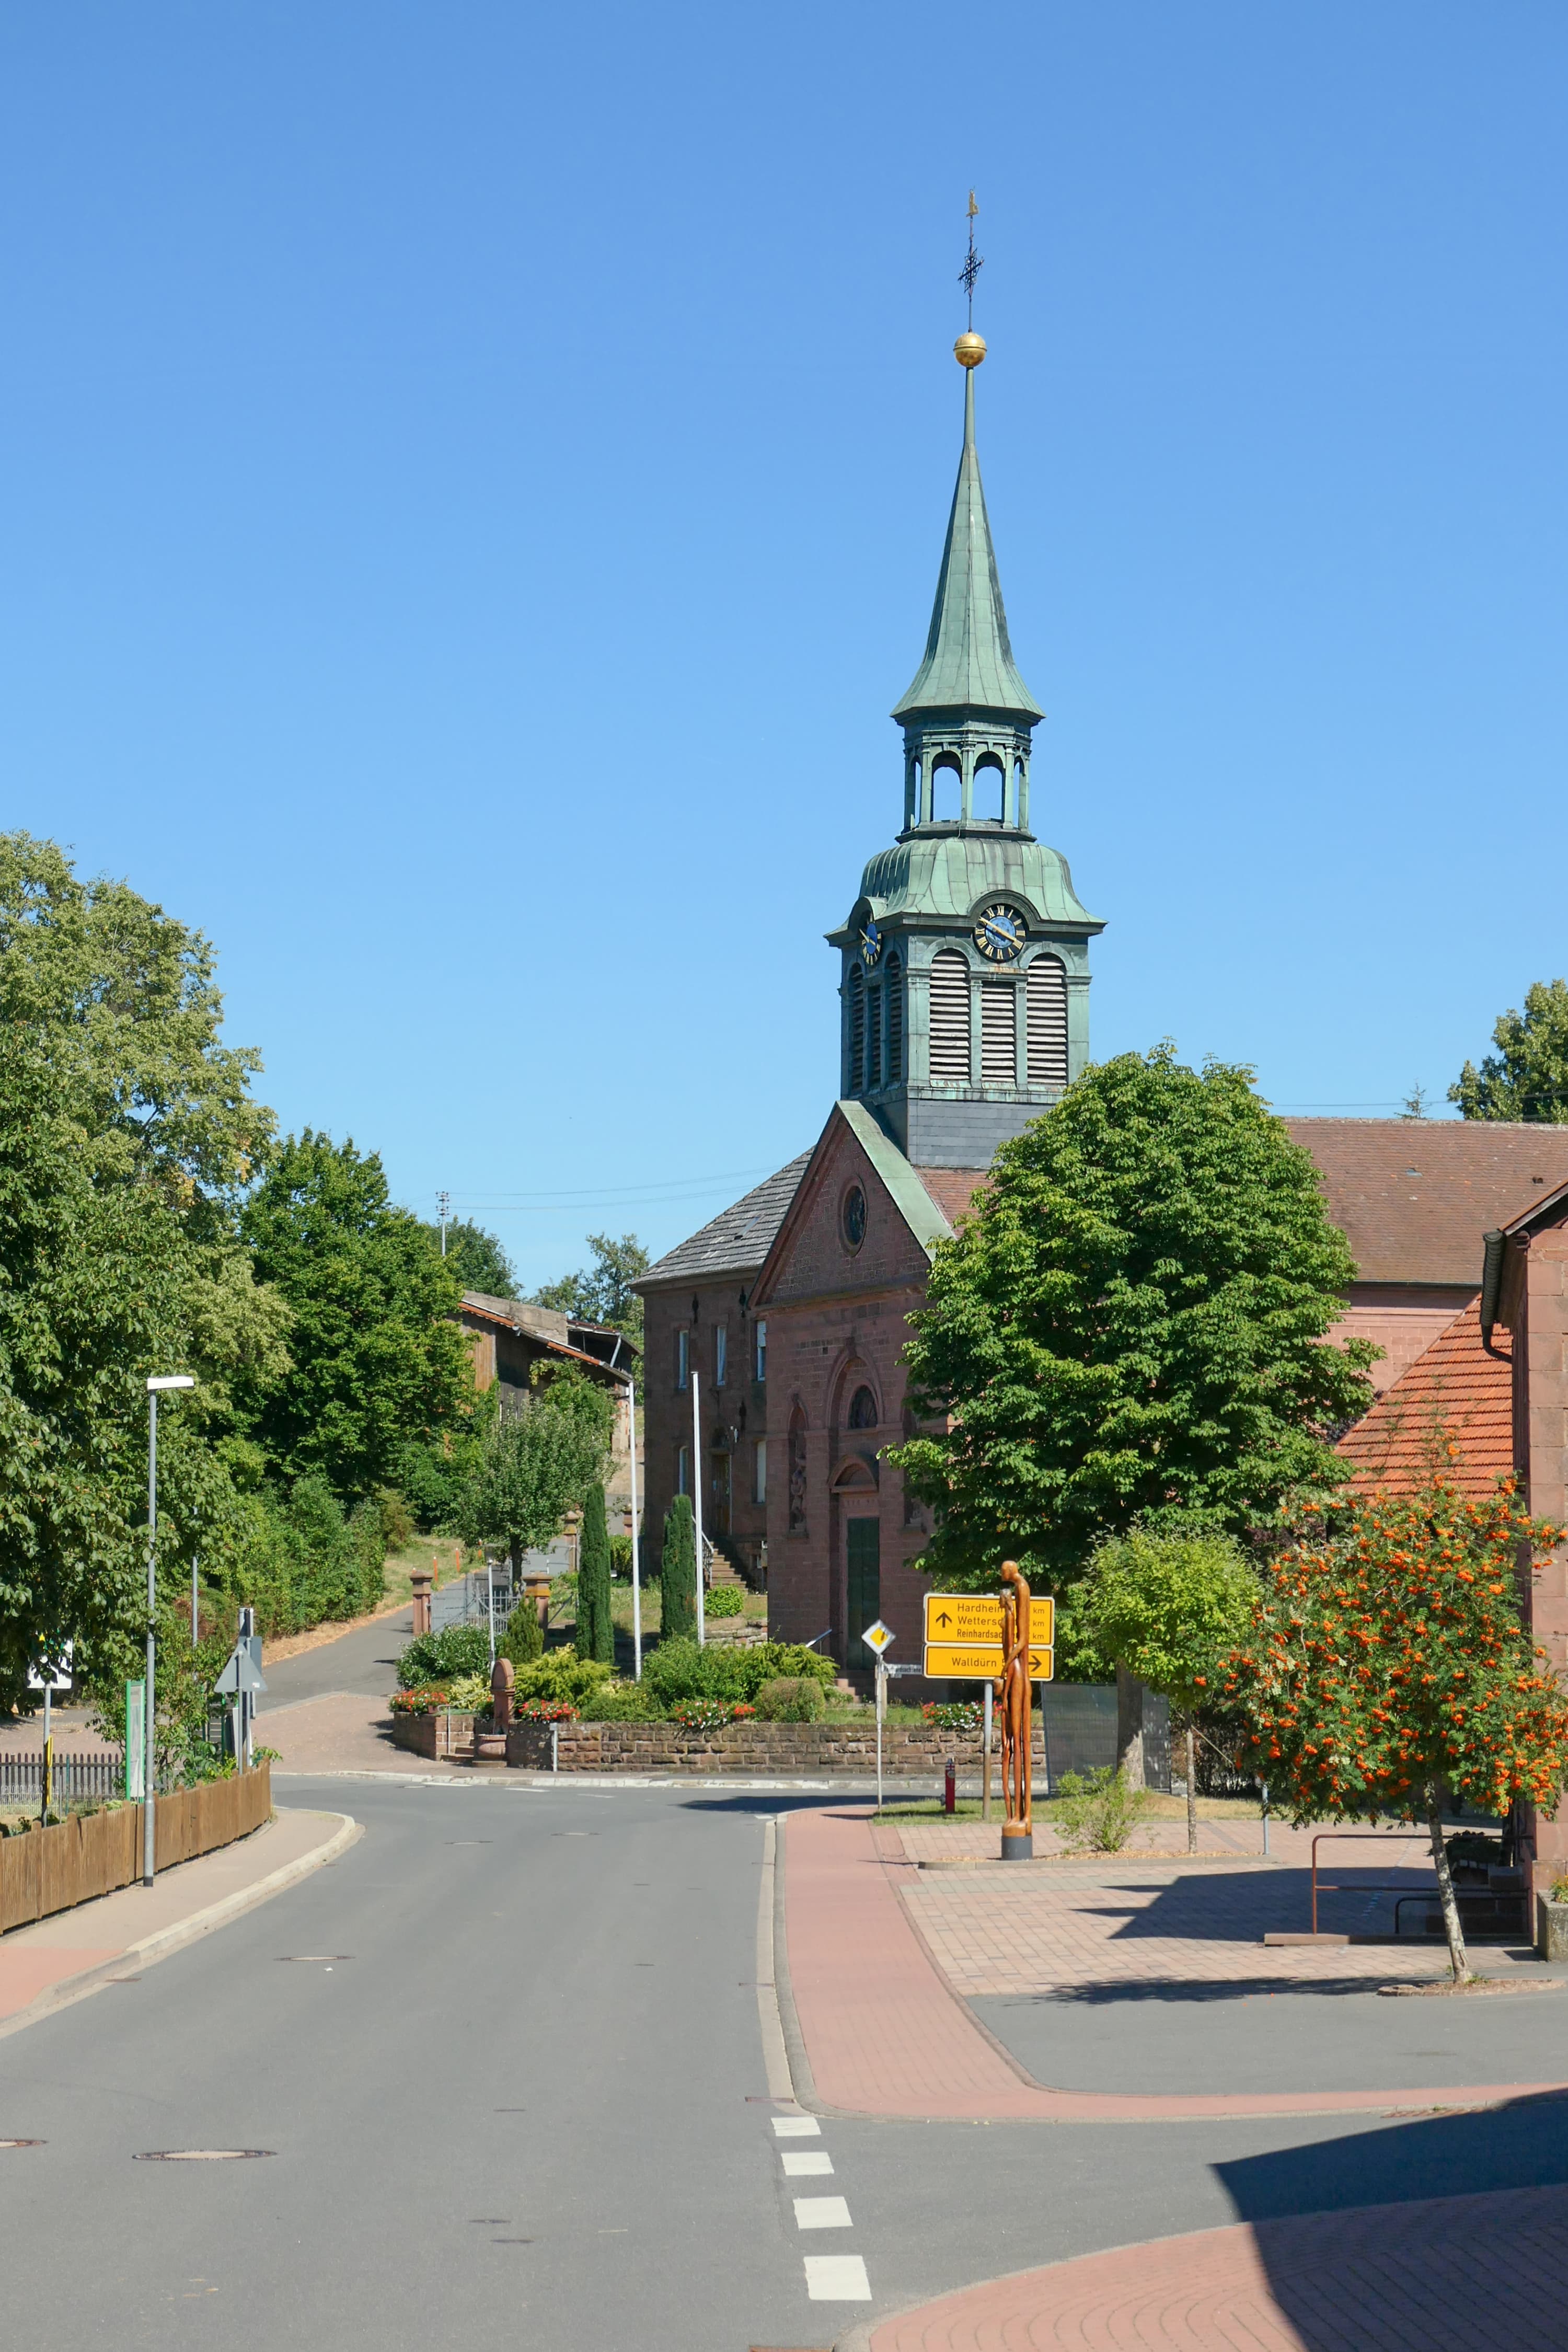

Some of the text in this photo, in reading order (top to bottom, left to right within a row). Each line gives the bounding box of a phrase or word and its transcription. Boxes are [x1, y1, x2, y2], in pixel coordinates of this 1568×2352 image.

[986, 907, 995, 918] XI
[996, 905, 1005, 916] XII
[1008, 909, 1013, 918] I
[997, 949, 1004, 959] VI
[1008, 947, 1014, 957] V
[952, 1657, 997, 1667] Walldürn
